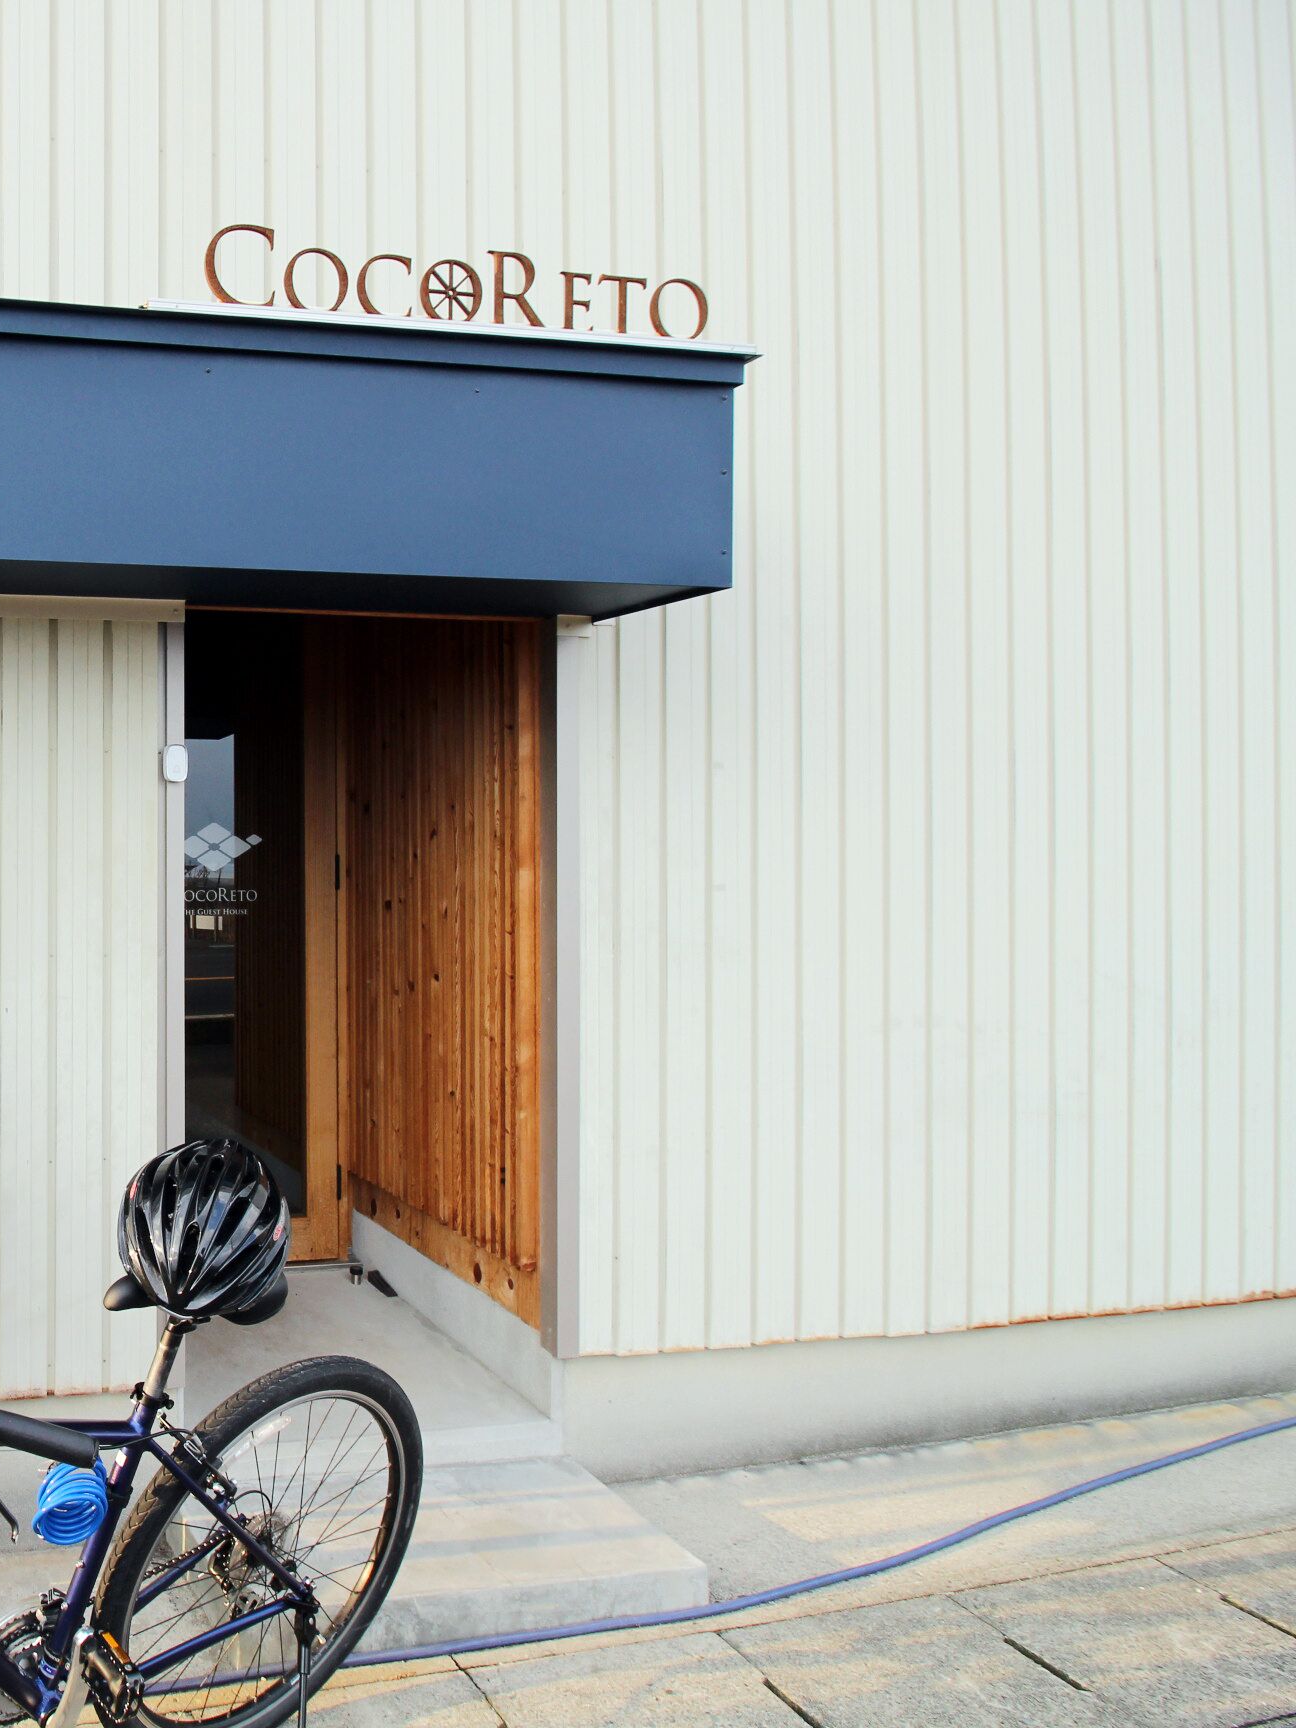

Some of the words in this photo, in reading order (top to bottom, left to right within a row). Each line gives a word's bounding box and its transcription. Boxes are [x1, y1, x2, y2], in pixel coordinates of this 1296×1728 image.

[184, 887, 258, 902] OCORETO
[184, 908, 195, 916] HE
[197, 908, 221, 916] GUEST
